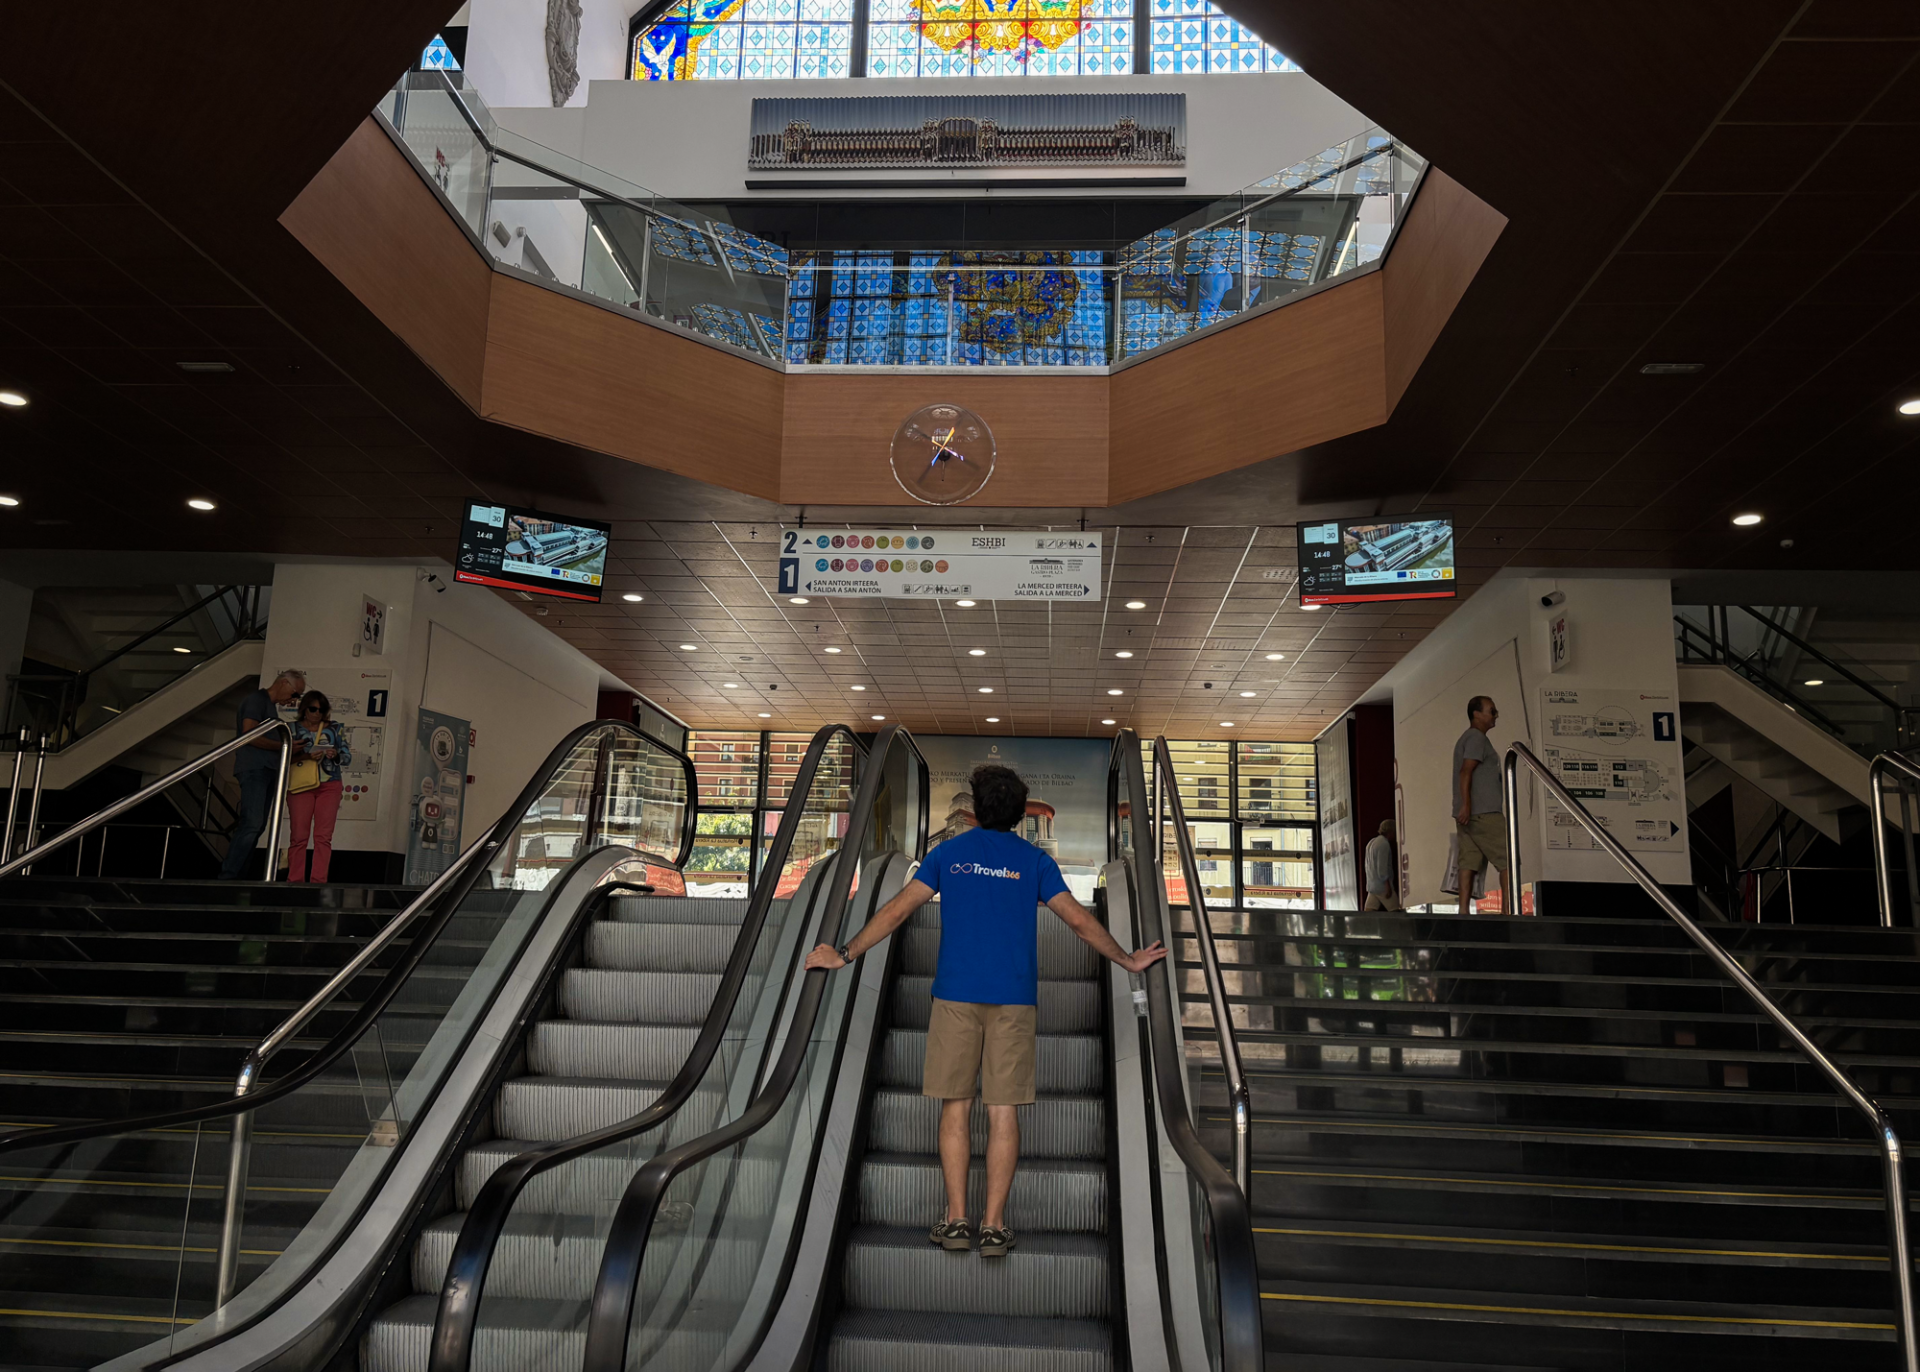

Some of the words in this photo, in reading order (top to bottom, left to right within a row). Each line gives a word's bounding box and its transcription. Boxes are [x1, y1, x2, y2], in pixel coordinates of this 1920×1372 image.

[783, 531, 798, 554] 2
[972, 537, 1006, 547] ESHBI
[1313, 551, 1331, 559] 14:48
[784, 564, 795, 588] 1
[366, 602, 377, 618] WC
[373, 692, 383, 713] 1
[1658, 715, 1670, 737] 1
